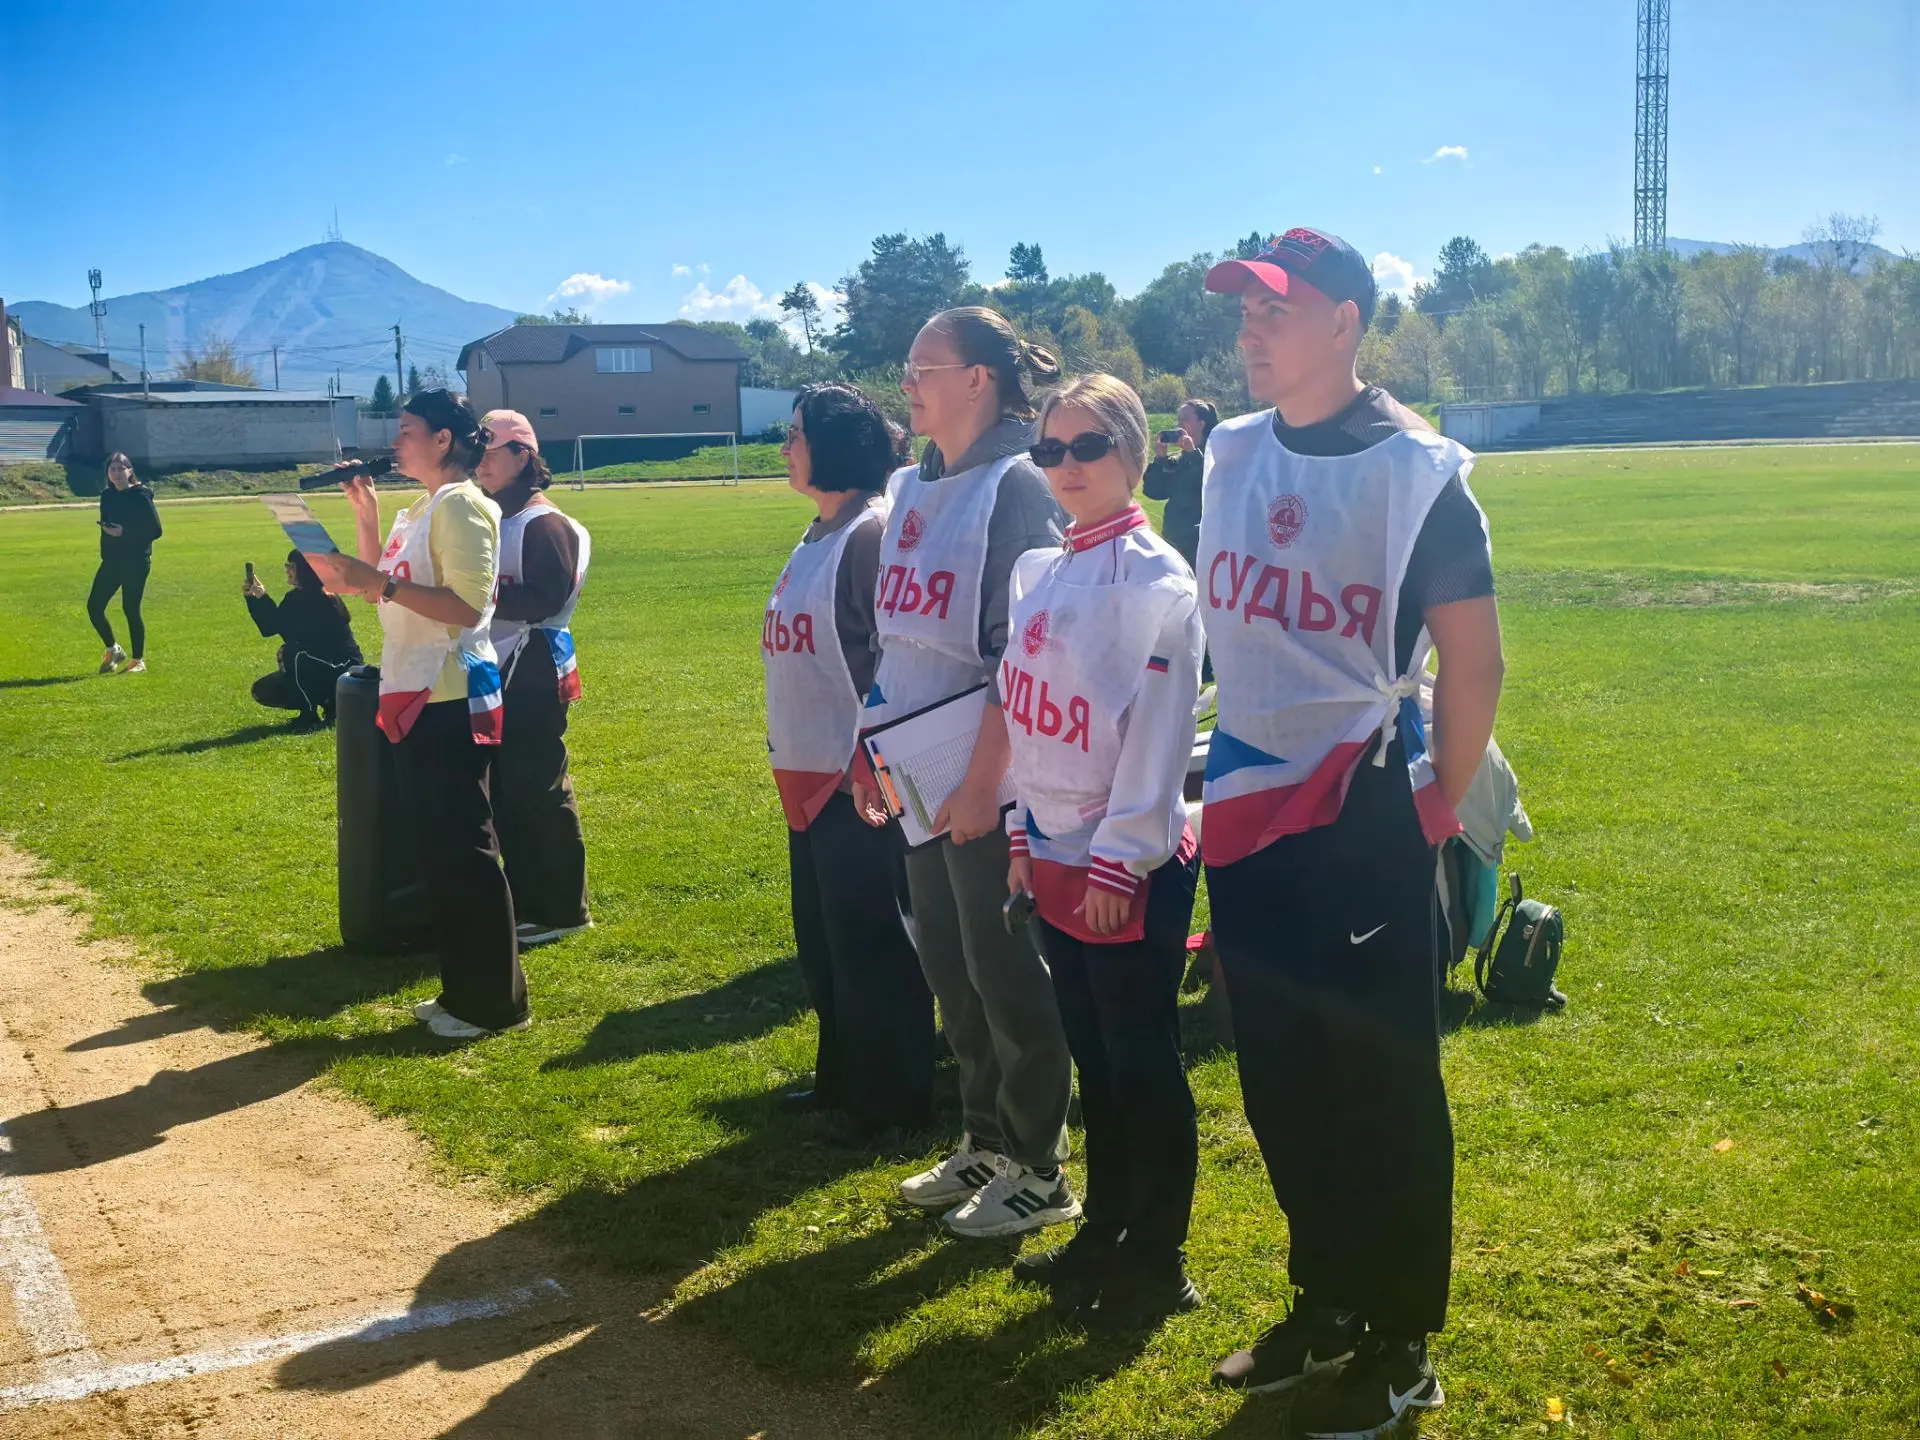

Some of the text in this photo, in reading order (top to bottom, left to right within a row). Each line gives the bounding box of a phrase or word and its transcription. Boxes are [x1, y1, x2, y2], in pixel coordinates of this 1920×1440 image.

[877, 564, 956, 619] УДЬЯ
[1208, 550, 1382, 648] СУДЬЯ
[763, 610, 815, 656] ДЬЯ
[1002, 660, 1089, 752] УДЬЯ
